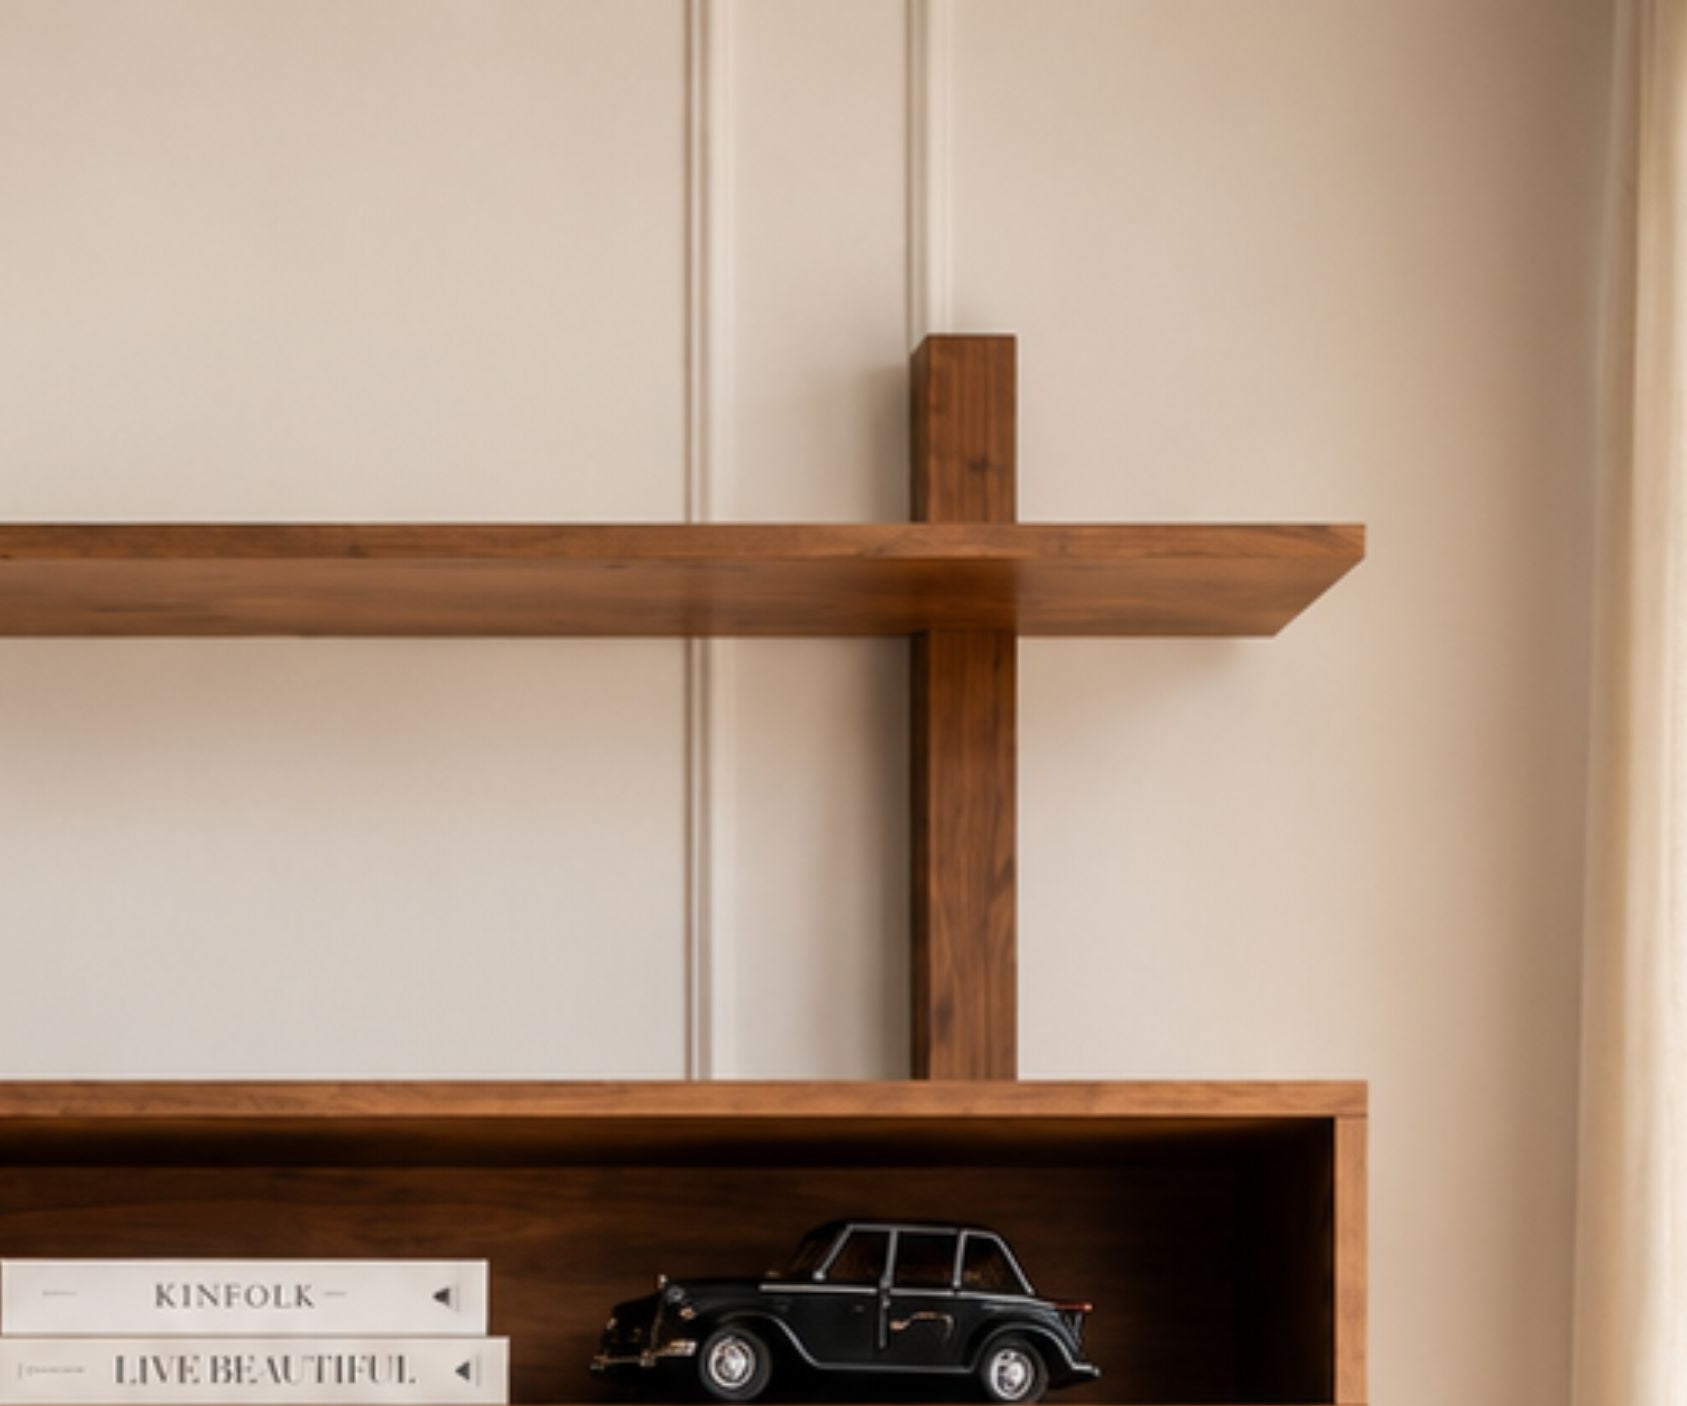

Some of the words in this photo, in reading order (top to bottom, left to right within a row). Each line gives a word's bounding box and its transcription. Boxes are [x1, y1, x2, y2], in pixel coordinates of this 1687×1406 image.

[154, 1283, 316, 1309] KINFOLK
[115, 1354, 201, 1385] LIVE
[210, 1354, 417, 1386] BEAUTIFUL
